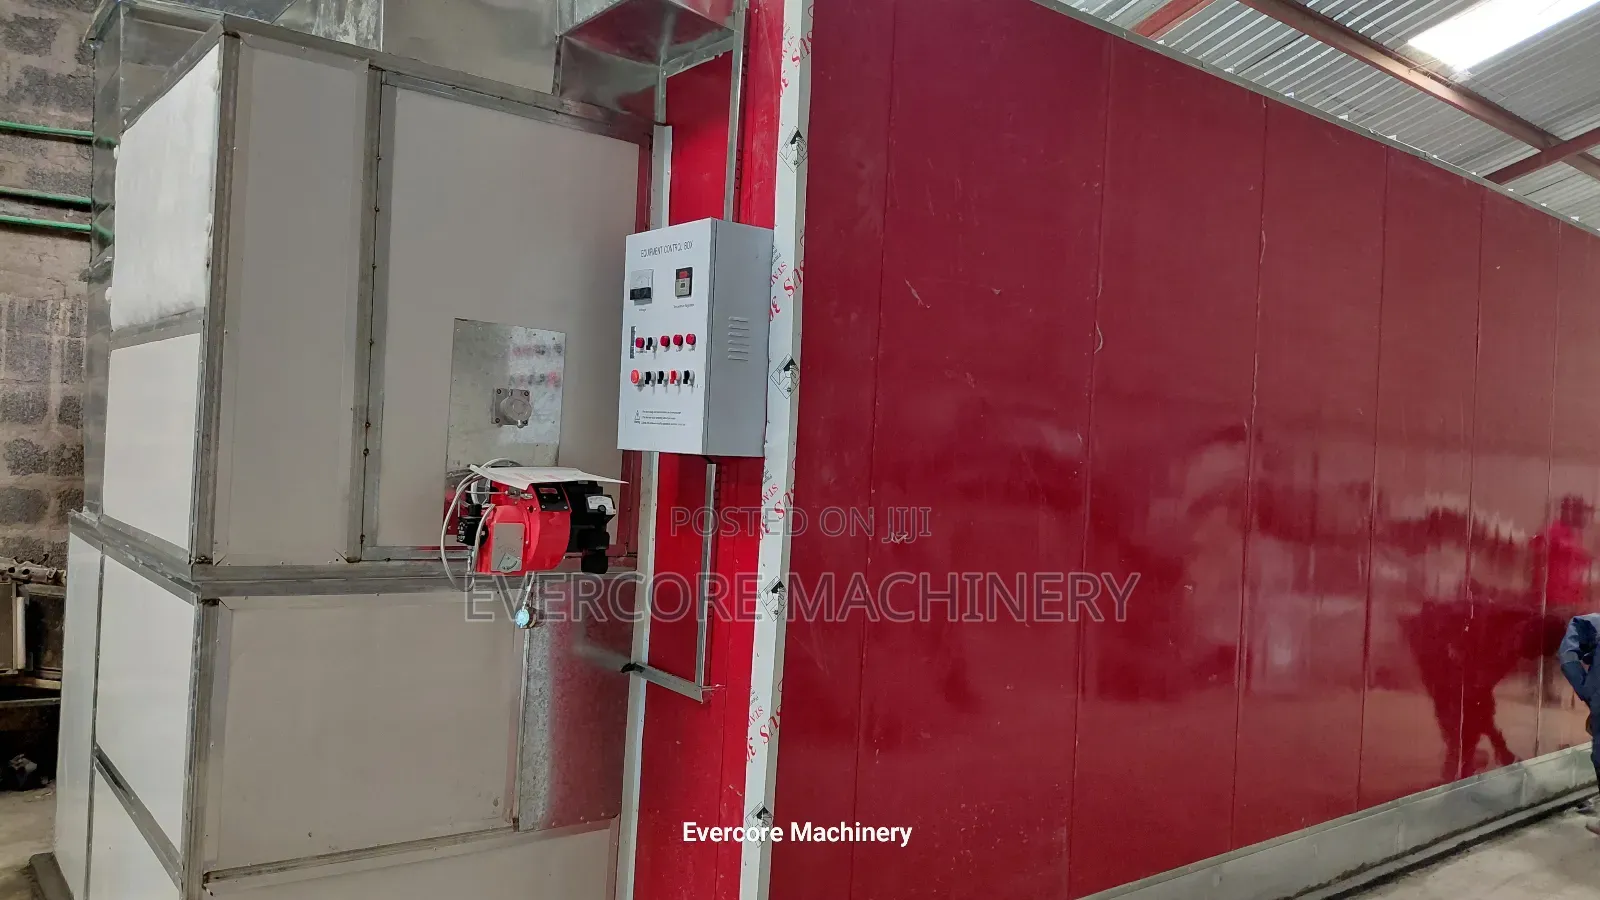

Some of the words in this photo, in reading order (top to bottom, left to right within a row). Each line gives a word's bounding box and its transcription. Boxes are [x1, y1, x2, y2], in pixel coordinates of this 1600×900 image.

[640, 245, 663, 258] EQUIPMENT
[663, 242, 683, 254] CONTROL
[683, 240, 694, 251] BOX
